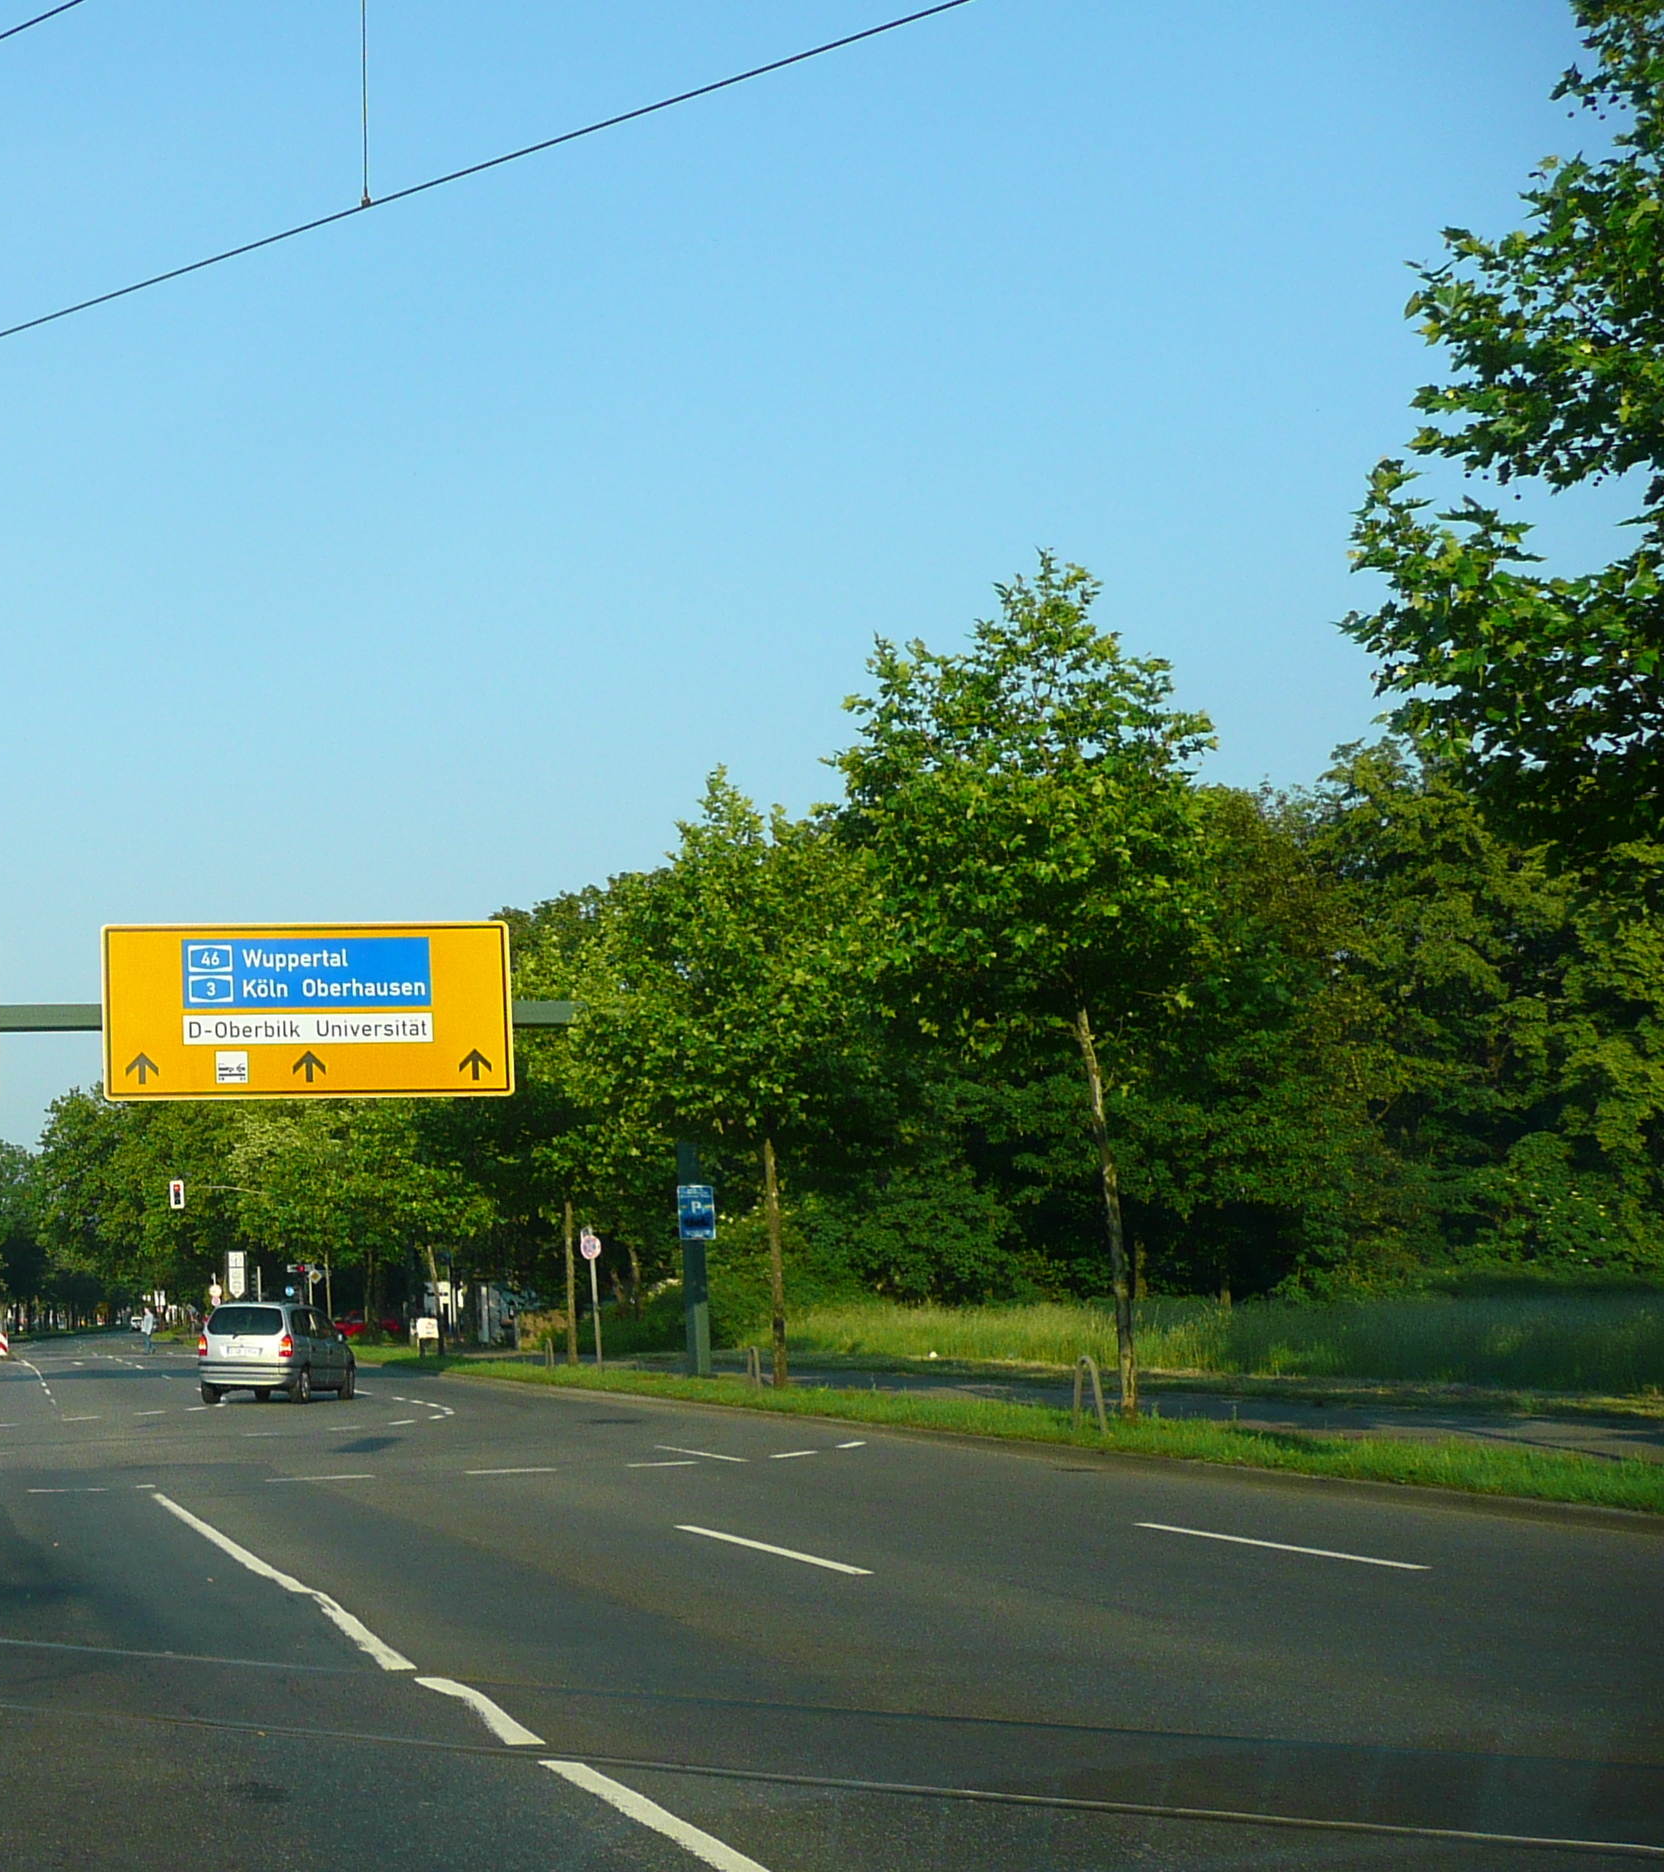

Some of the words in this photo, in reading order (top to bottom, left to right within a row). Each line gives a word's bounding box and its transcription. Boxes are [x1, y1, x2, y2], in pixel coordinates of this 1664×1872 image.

[201, 951, 220, 966] 46
[242, 949, 349, 972] Wuppertal
[205, 981, 216, 997] 3
[242, 977, 288, 998] Köln
[302, 978, 426, 998] Oberhausen
[188, 1020, 301, 1039] D-Oberbilk
[316, 1018, 428, 1038] Universität
